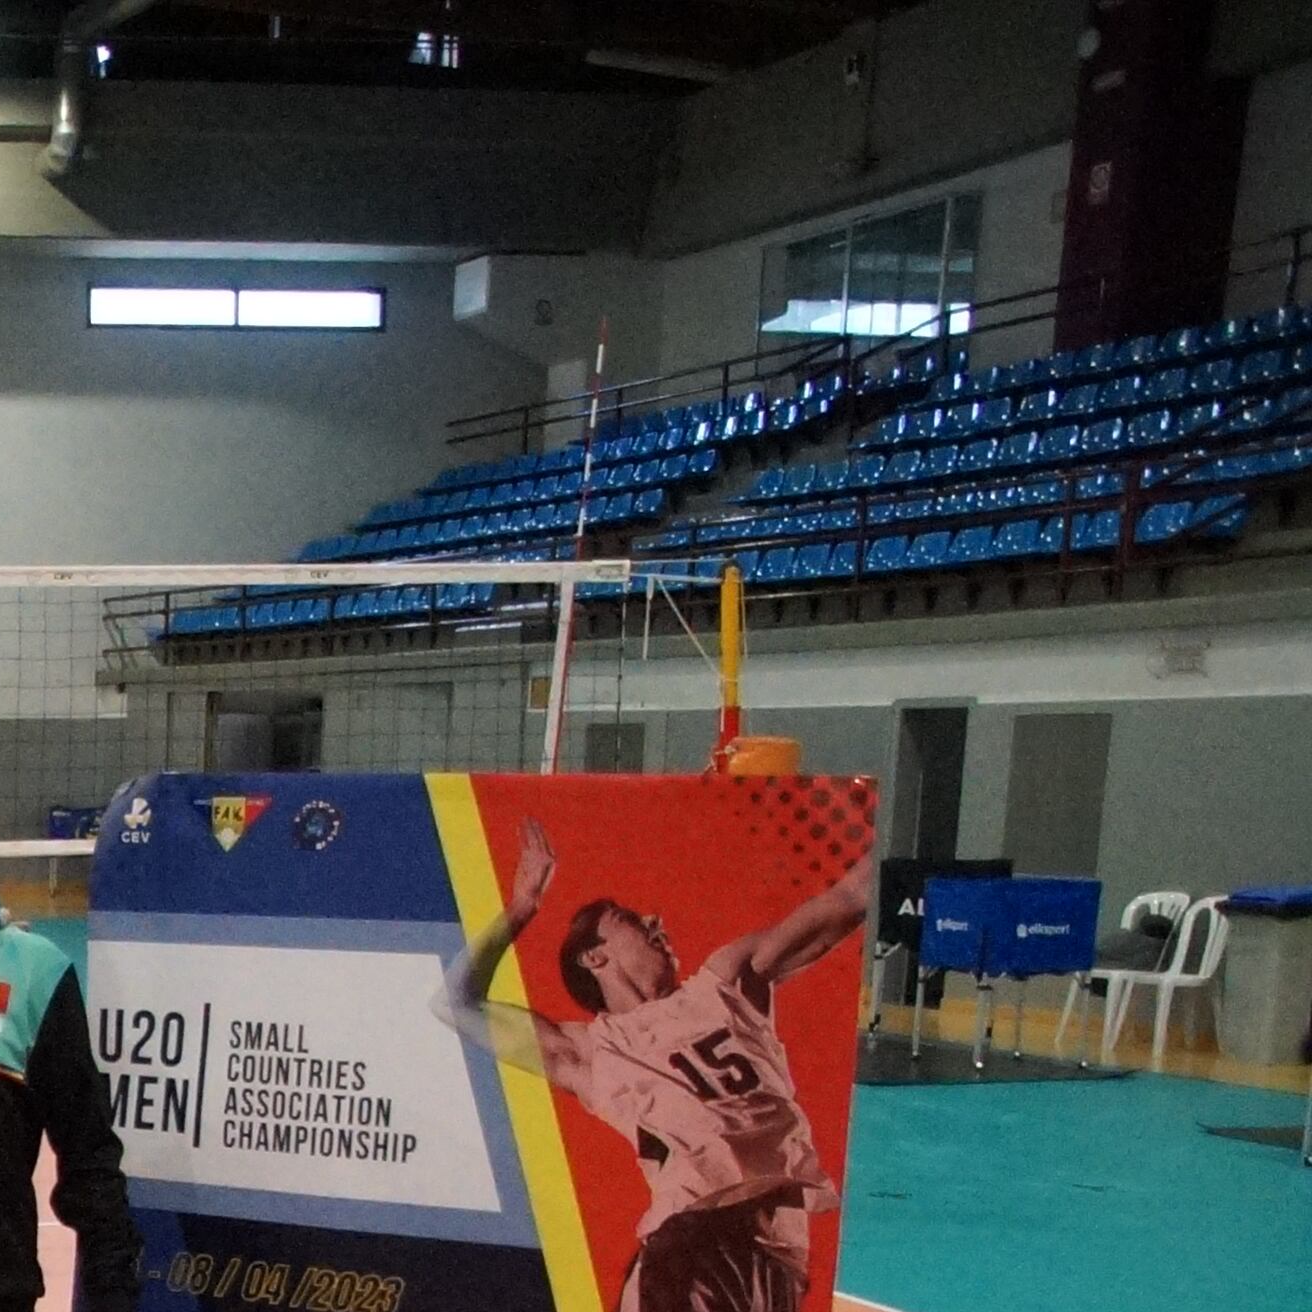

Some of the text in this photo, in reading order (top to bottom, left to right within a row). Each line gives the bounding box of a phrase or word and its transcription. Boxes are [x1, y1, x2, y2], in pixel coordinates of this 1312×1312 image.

[121, 832, 151, 844] CEV
[99, 1007, 186, 1067] U20
[229, 1020, 309, 1054] SMALL
[227, 1053, 368, 1092] COUNTRIES
[668, 1026, 762, 1103] 15
[99, 1071, 190, 1134] MEN
[224, 1086, 393, 1128] ASSOCIATION
[222, 1119, 418, 1164] CHAMPIONSHIP
[167, 1251, 214, 1295] 08
[241, 1260, 290, 1305] 04
